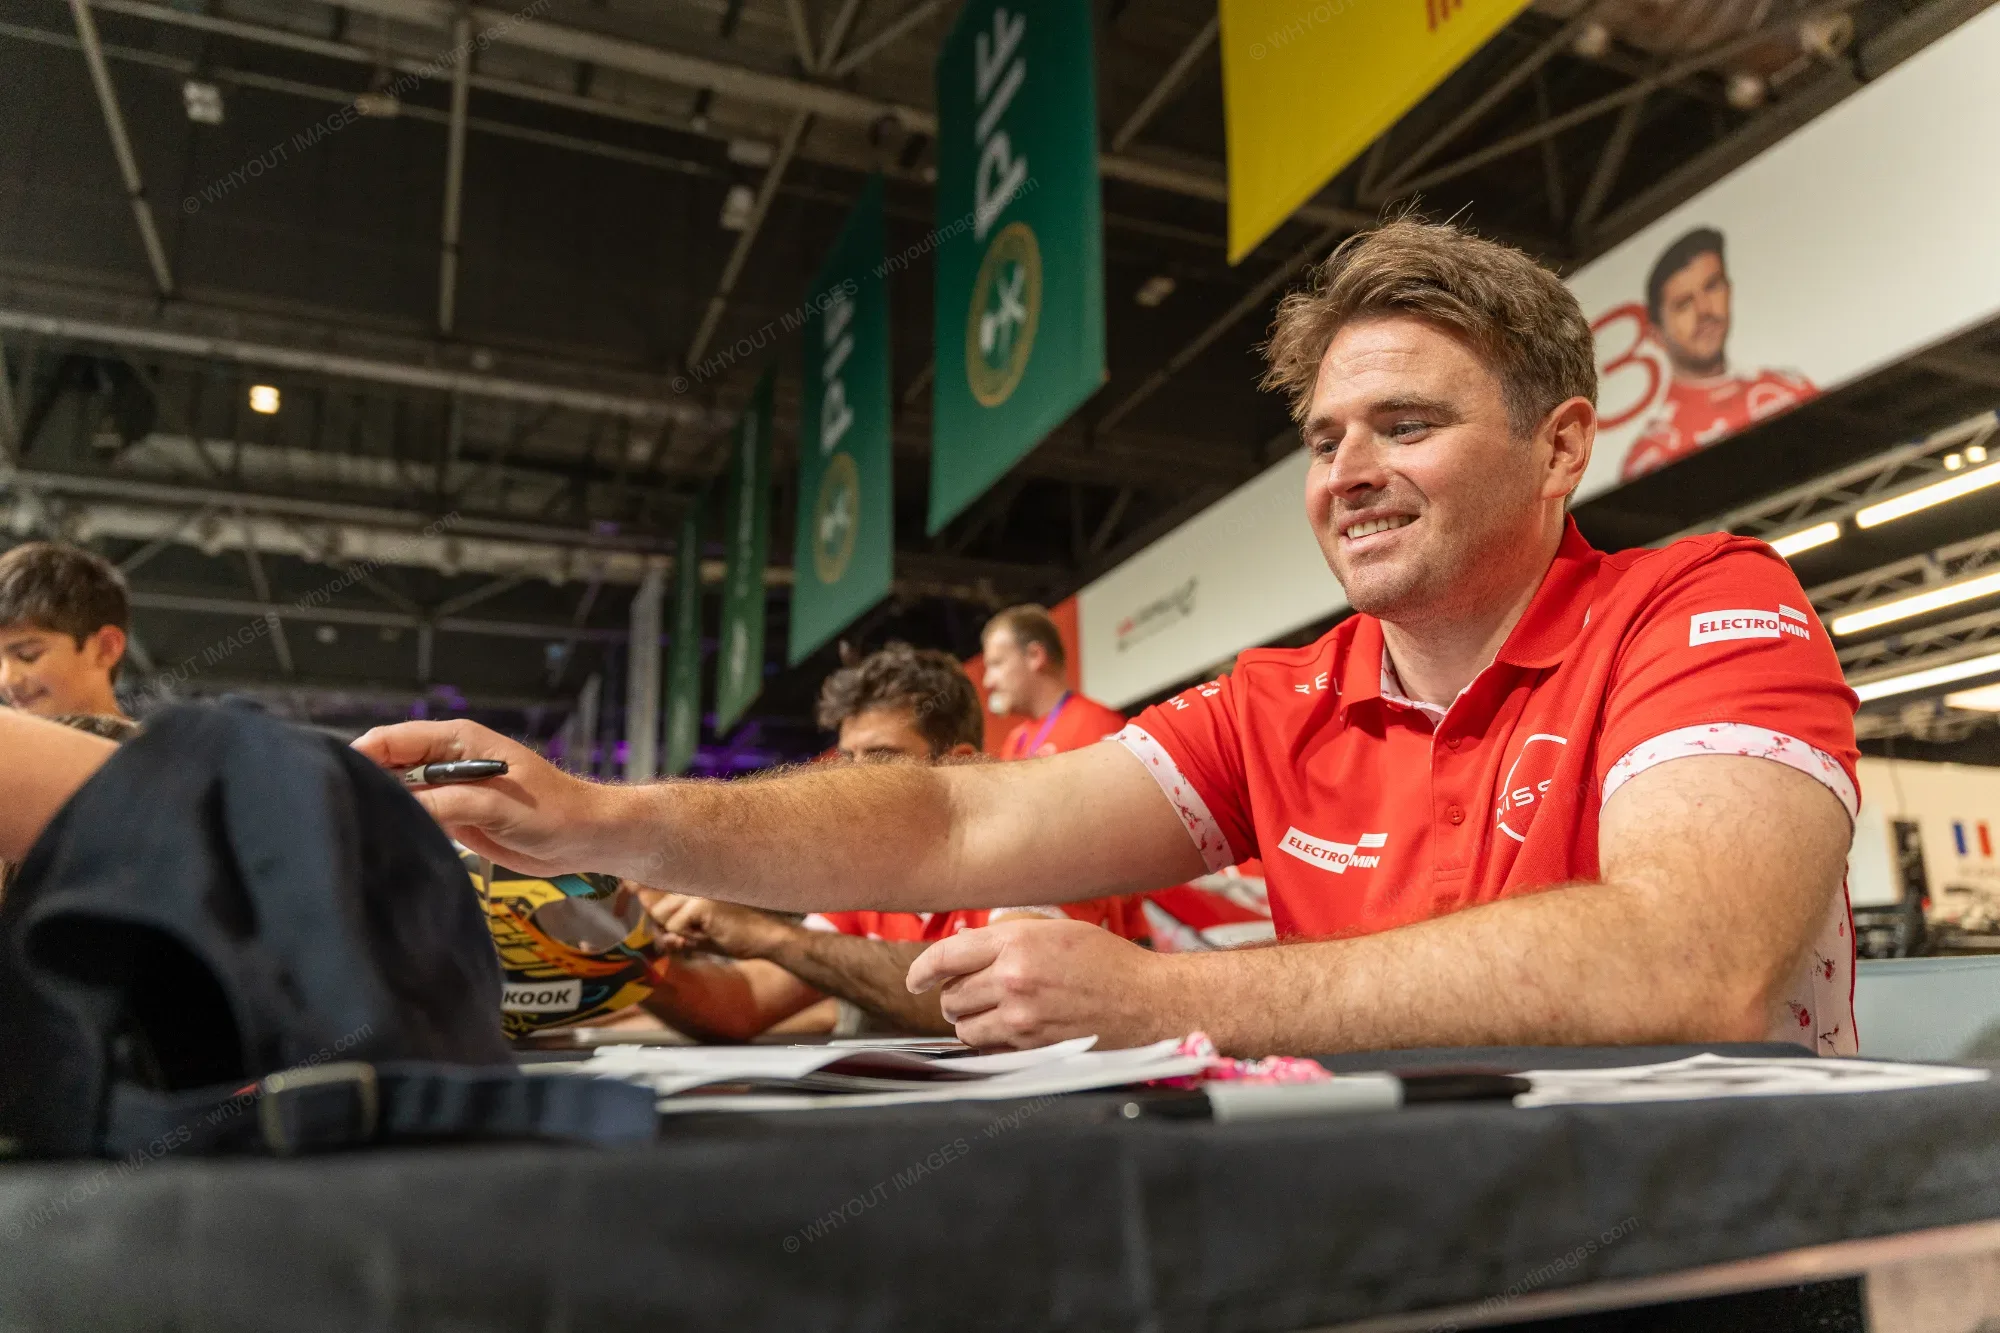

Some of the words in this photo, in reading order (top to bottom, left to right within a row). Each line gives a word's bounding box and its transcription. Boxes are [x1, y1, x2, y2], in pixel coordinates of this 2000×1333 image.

[974, 6, 1028, 243] PIF
[1698, 617, 1811, 641] ELECTROMIN
[1288, 836, 1381, 868] ELECTROMIN
[503, 988, 572, 1005] KOOK
